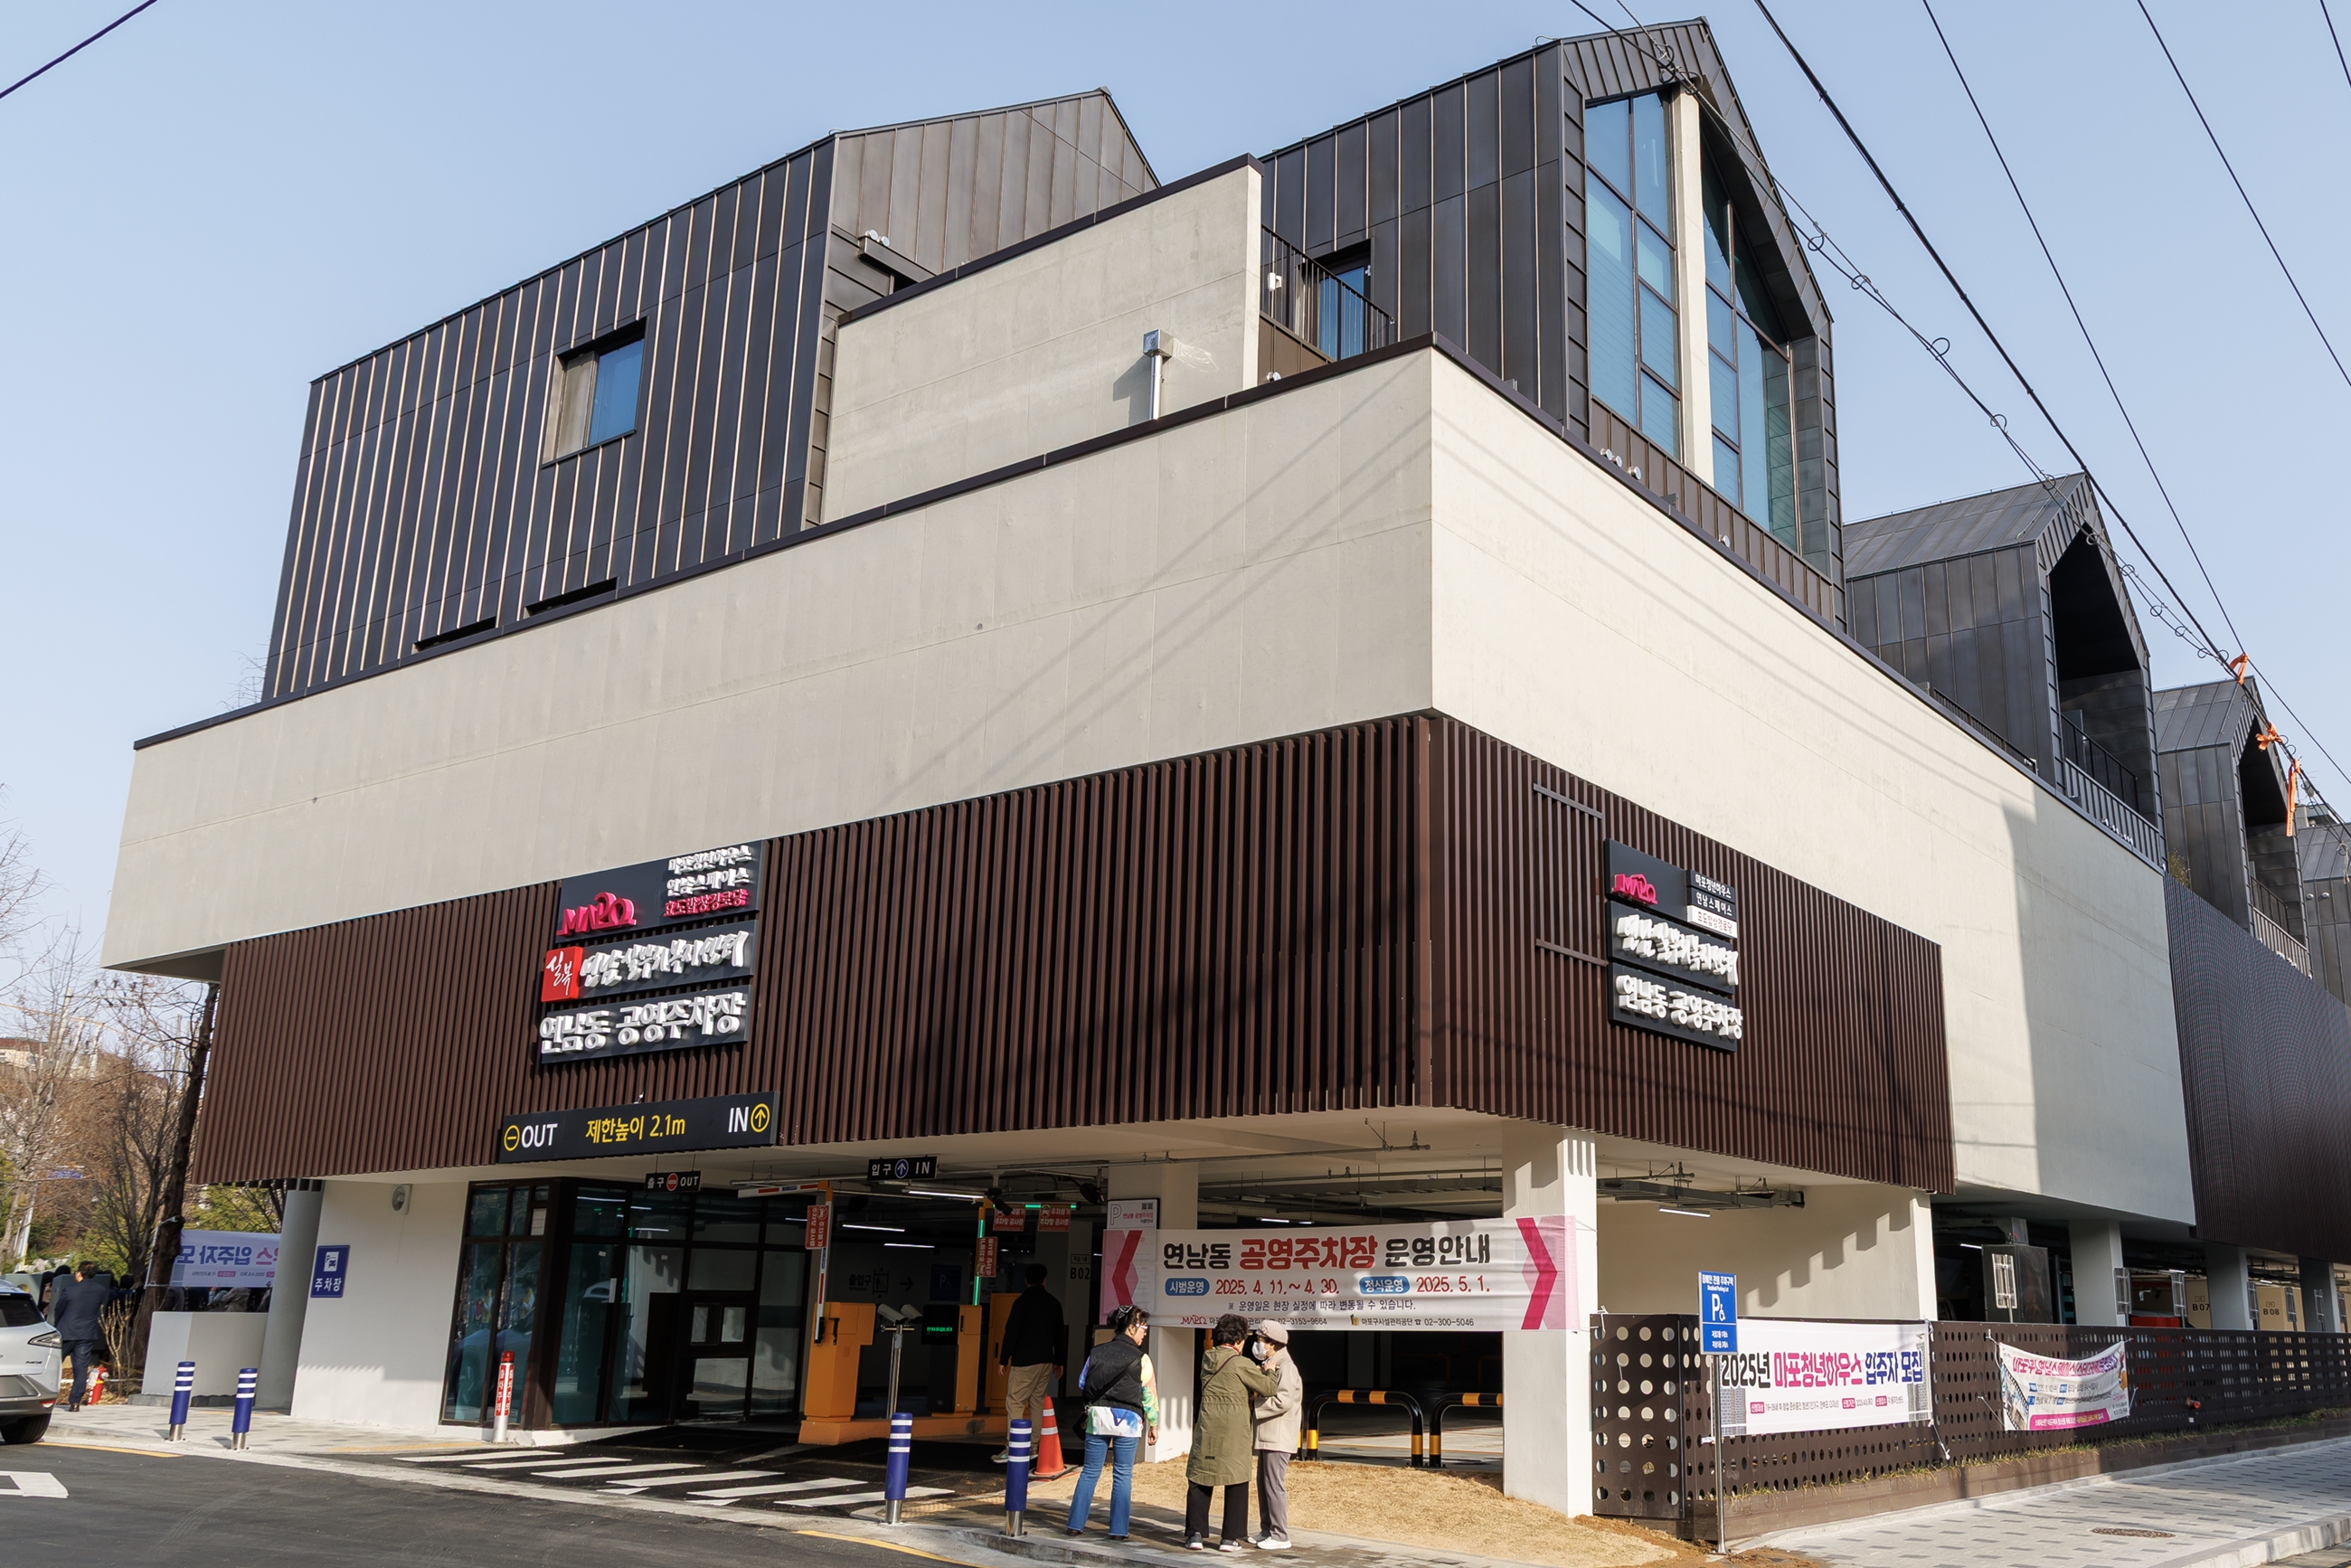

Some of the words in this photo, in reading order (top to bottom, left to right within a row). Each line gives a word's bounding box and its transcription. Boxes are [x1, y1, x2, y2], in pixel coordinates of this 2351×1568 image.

[668, 845, 752, 874] 마포청년하우스
[666, 867, 750, 896] 연남스페이스
[1695, 874, 1732, 898] 마포청년하우스
[556, 892, 637, 937] MAPO
[664, 889, 748, 917] 효도밥상경로당
[1696, 893, 1733, 916] 연남스페이스
[1616, 975, 1668, 1018] 연남동
[1669, 991, 1742, 1039] 공영주차장
[540, 1010, 610, 1053] 연남동
[616, 992, 746, 1045] 공영주차장
[585, 1116, 645, 1144] 제한높이
[649, 1114, 685, 1138] 2.1m
[728, 1107, 749, 1133] IN
[521, 1123, 558, 1148] OUT
[872, 1164, 892, 1176] 입구
[916, 1161, 930, 1174] IN
[647, 1176, 665, 1189] 출구
[680, 1176, 699, 1187] OUT
[1110, 1204, 1122, 1226] P
[1164, 1243, 1231, 1269] 연남동
[1239, 1235, 1378, 1270] 공영주차장
[1385, 1233, 1490, 1267] 운영안내
[315, 1278, 342, 1291] 주차장
[849, 1274, 872, 1286] 출입구
[1170, 1280, 1204, 1293] 시범운영
[1215, 1280, 1248, 1295] 2025.
[1253, 1279, 1263, 1295] 4.
[1321, 1278, 1339, 1295] 30.
[1364, 1280, 1404, 1293] 정식운영
[1416, 1276, 1454, 1293] 2025.
[1458, 1276, 1471, 1293] 5.
[1478, 1275, 1490, 1292] 1.
[1239, 1300, 1270, 1311] 운영일은
[1273, 1300, 1289, 1311] 현장
[1293, 1300, 1317, 1311] 실정에
[1320, 1300, 1336, 1310] 따라
[1339, 1299, 1364, 1311] 변동될
[1367, 1300, 1376, 1309] 수
[1379, 1299, 1416, 1310] 있습니다.
[1712, 1293, 1721, 1321] P
[1278, 1318, 1327, 1326] 02-3153-9664
[1361, 1318, 1413, 1327] 마포구시설관리공단
[1424, 1318, 1475, 1327] 02-300-5046
[1721, 1351, 1771, 1389] 2025년
[1774, 1351, 1863, 1388] 마포청년하우스
[1865, 1351, 1899, 1384] 입주자
[1901, 1350, 1923, 1383] 모집
